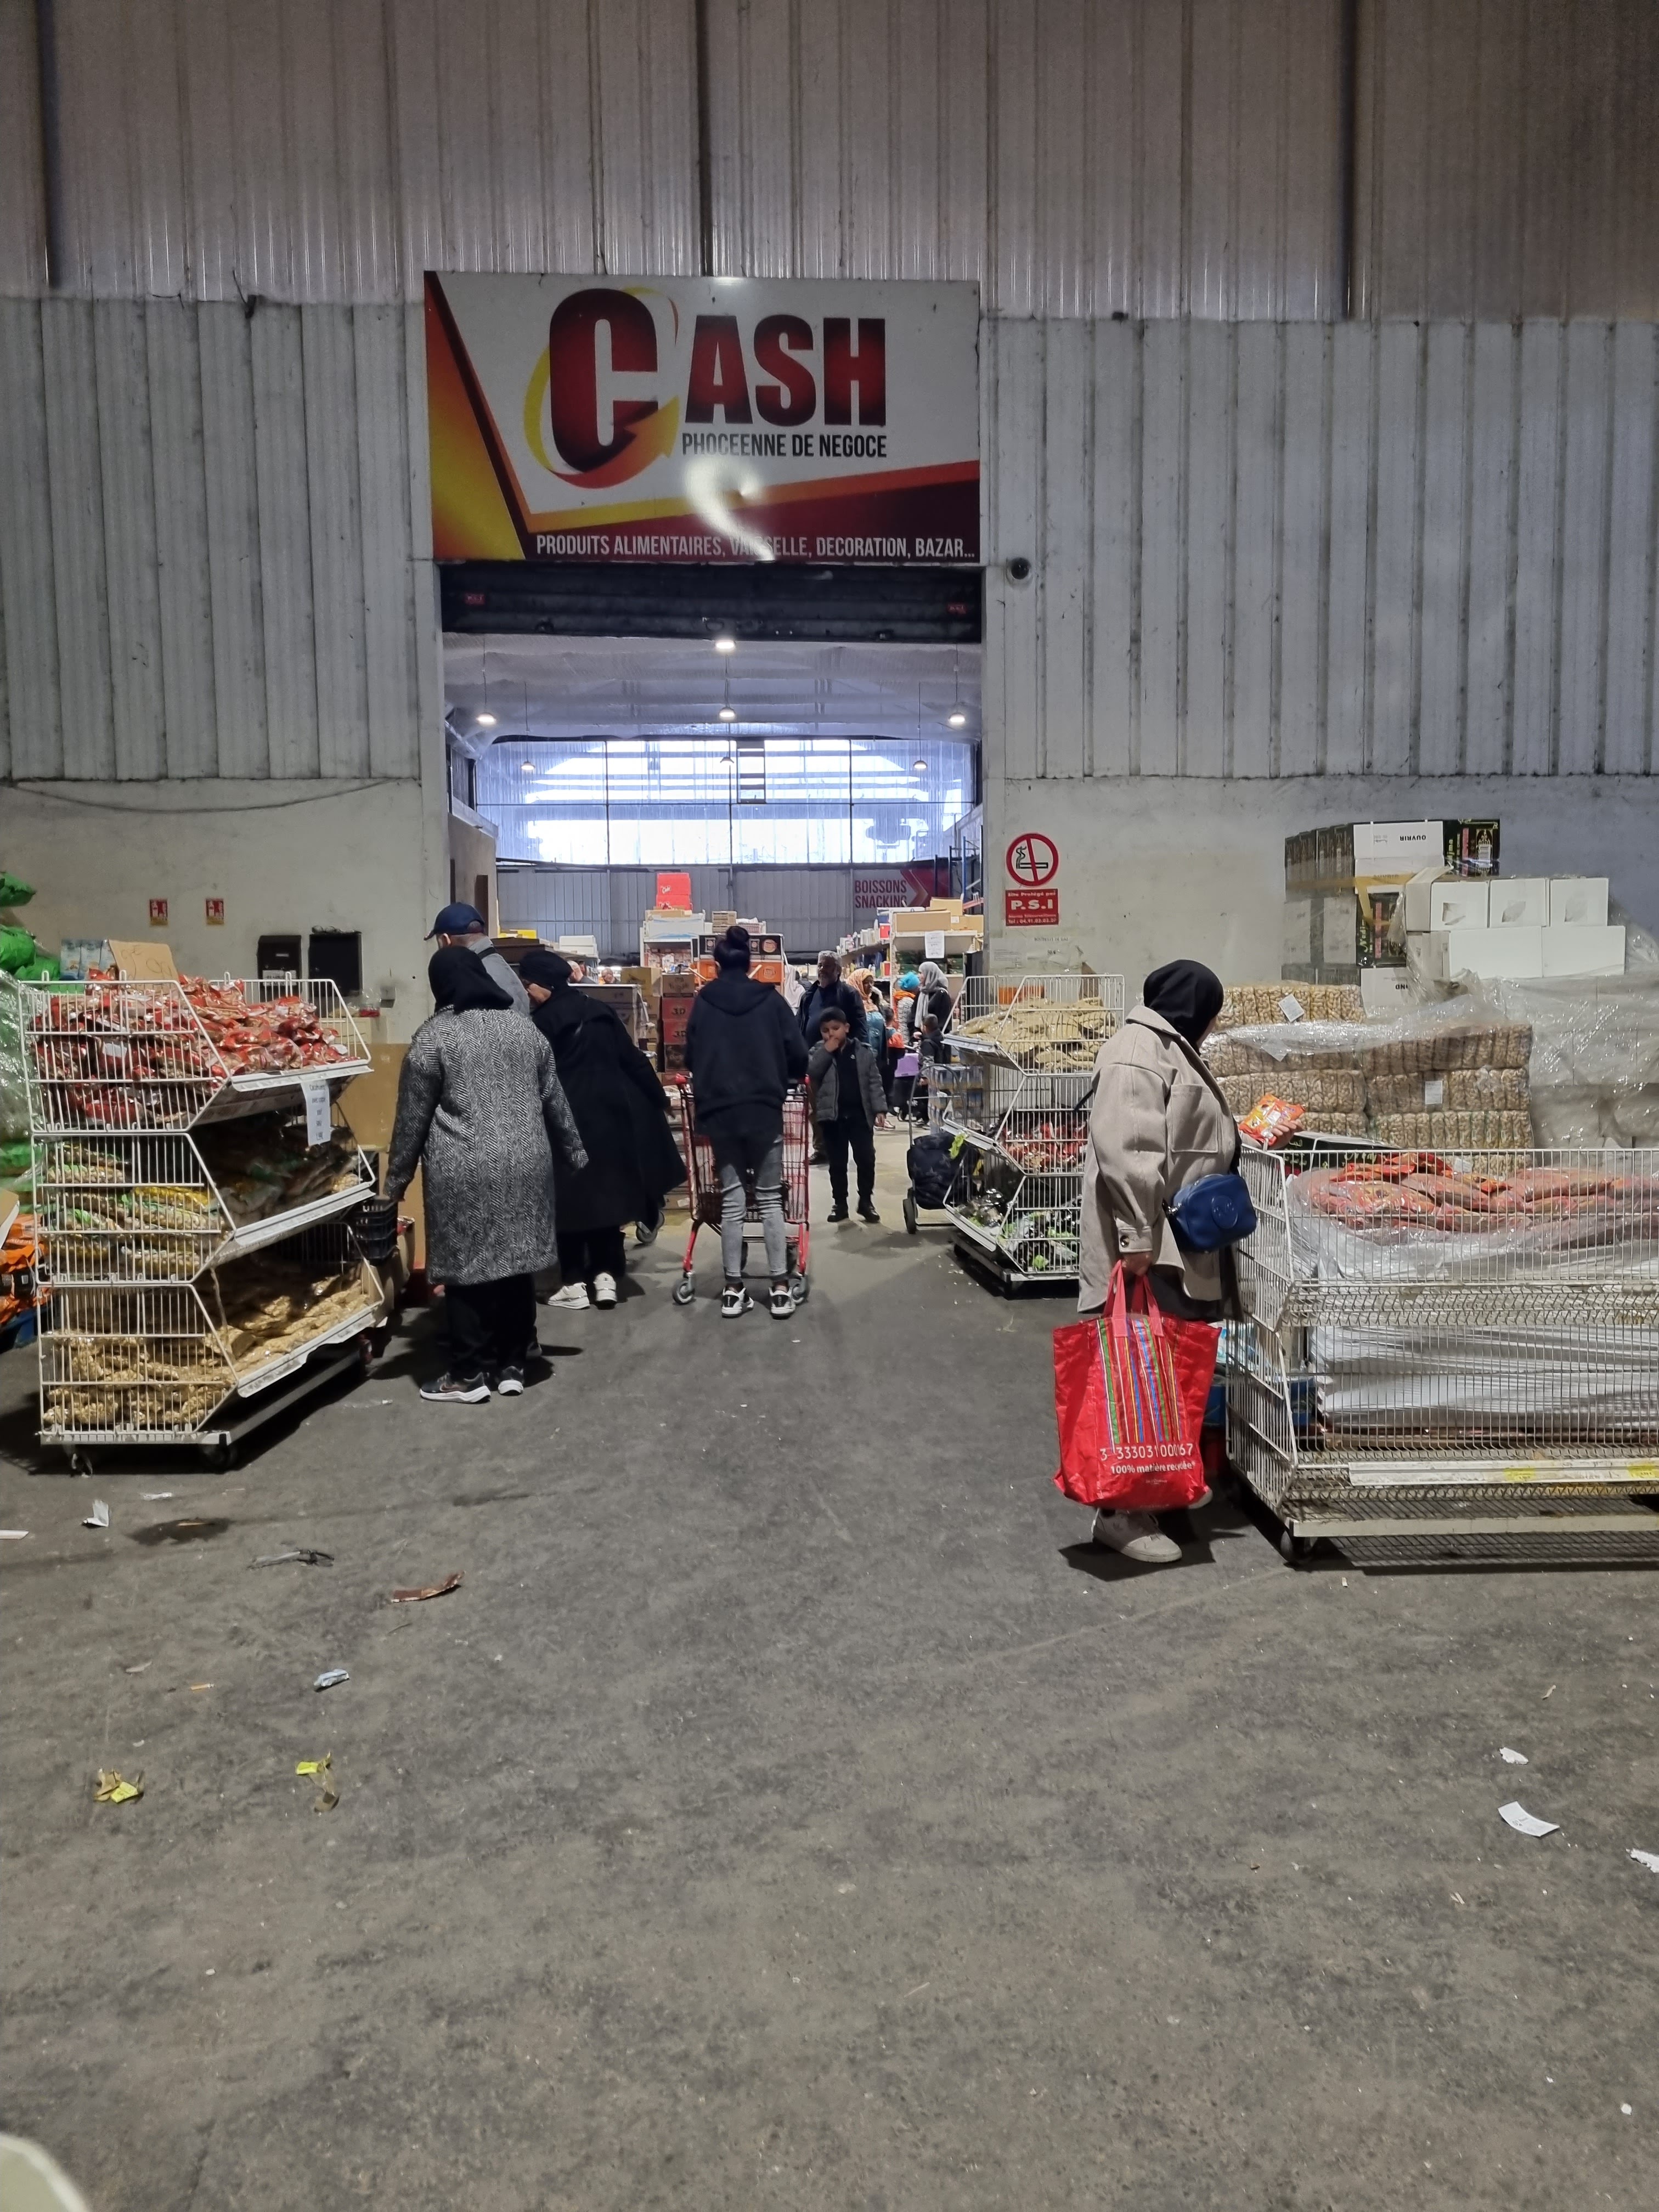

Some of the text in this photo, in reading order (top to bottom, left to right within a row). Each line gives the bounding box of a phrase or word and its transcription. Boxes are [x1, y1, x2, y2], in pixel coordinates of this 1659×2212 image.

[549, 288, 886, 473] CASH
[682, 432, 887, 458] PHOCEENNE DE NEGOCE
[537, 535, 975, 558] PRODUITS ALIMENTAIRES, VAIELLE, DECORATION, BAZAR...
[855, 879, 907, 894] BOISSONS
[855, 894, 907, 909] SNACKING
[1011, 899, 1053, 910] P.S.I
[1100, 1448, 1108, 1462] 3
[1110, 1465, 1135, 1474] 100%
[1137, 1463, 1165, 1473] matière
